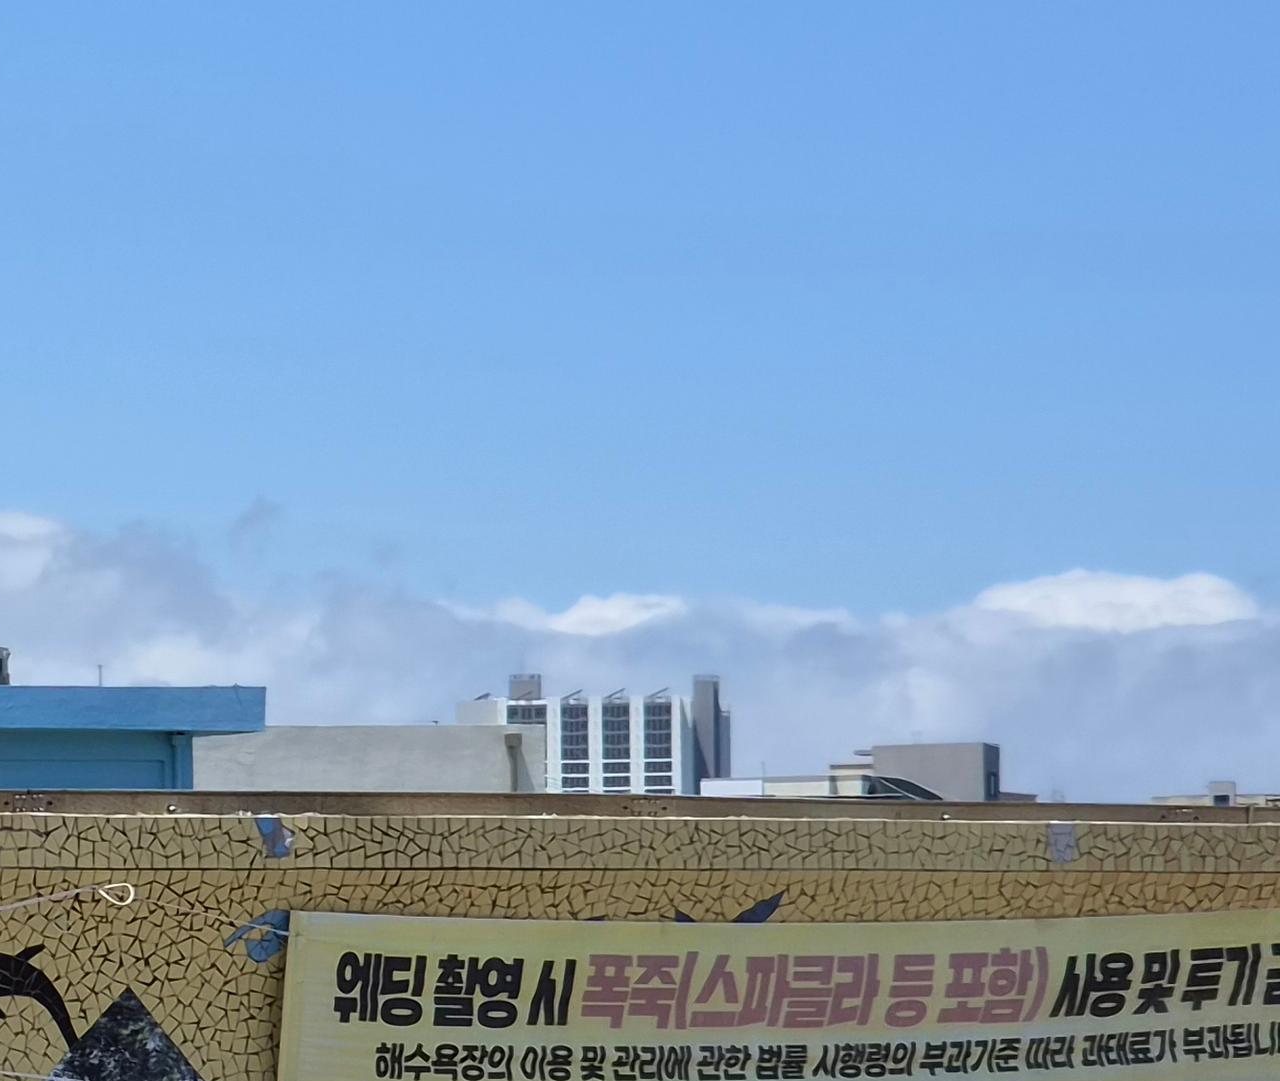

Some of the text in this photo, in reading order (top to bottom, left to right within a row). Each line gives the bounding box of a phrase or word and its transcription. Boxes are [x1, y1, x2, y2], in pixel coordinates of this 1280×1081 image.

[334, 952, 427, 1026] 웨딩
[433, 954, 524, 1029] 촬영
[527, 959, 576, 1026] 시
[581, 951, 880, 1029] 폭죽(스파클라
[885, 953, 936, 1028] 등
[937, 946, 1049, 1024] 포함)
[1048, 952, 1134, 1018] 사용
[1132, 949, 1180, 1015] 및
[1180, 943, 1261, 1011] 투기
[375, 1021, 1280, 1081] 해수욕장의 이용 및 관리에 관한 법률 시행령의 부과기준 따라 과태료가 부과됩니
